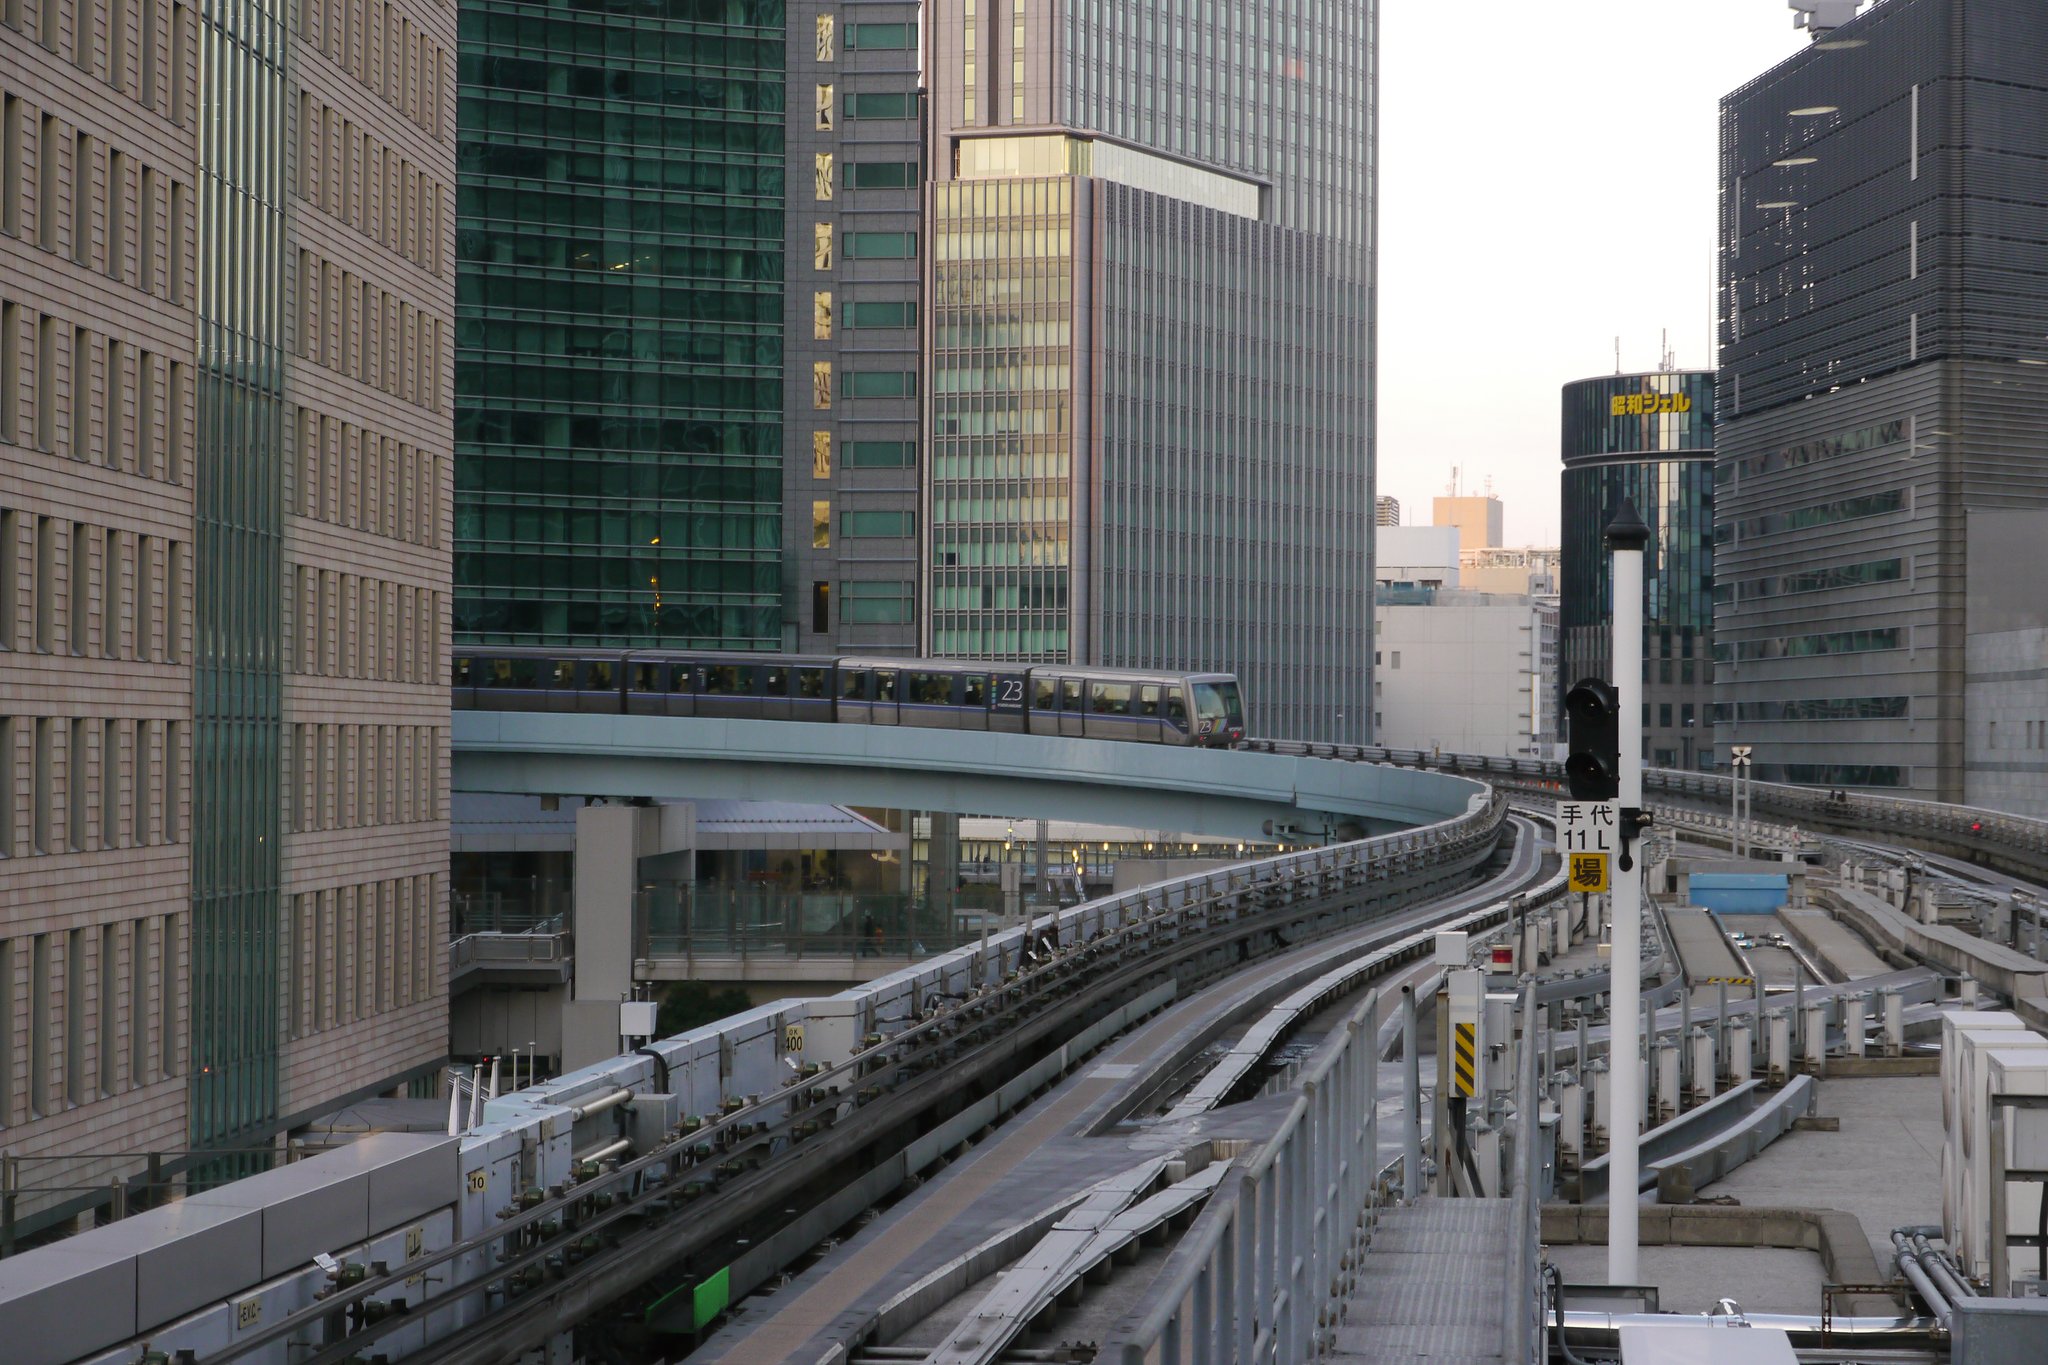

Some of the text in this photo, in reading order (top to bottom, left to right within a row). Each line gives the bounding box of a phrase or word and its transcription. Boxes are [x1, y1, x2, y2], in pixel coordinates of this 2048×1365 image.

[1611, 391, 1692, 416] 昭和シェル
[1001, 680, 1023, 701] 23
[1199, 720, 1212, 734] 23
[1573, 857, 1602, 887] 場
[471, 1176, 484, 1189] 10
